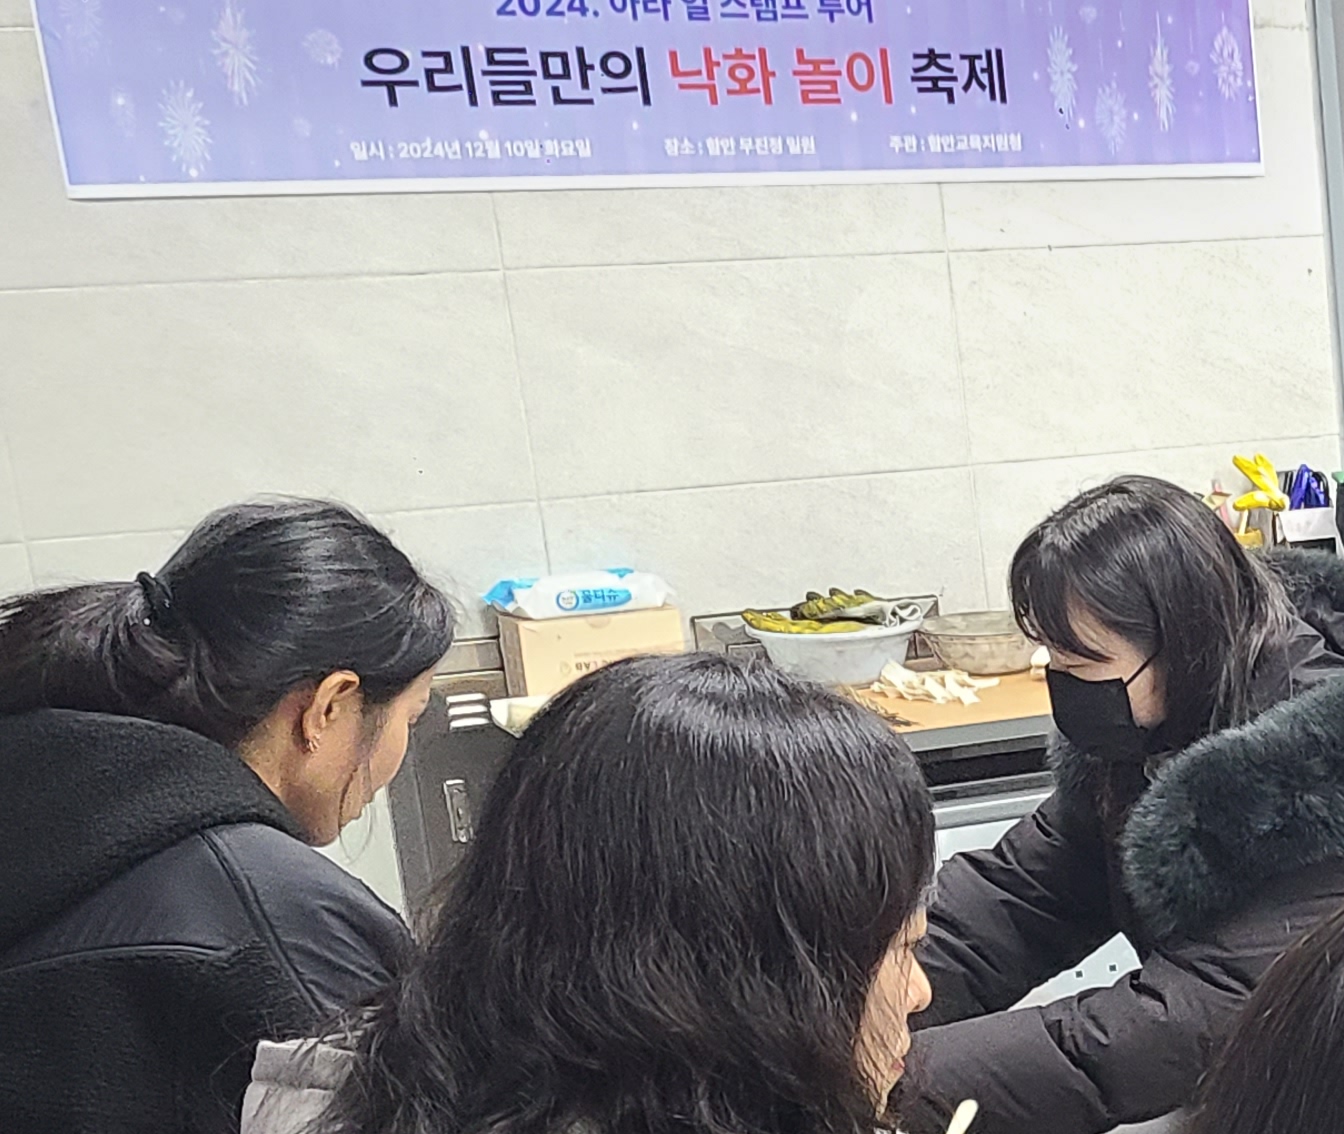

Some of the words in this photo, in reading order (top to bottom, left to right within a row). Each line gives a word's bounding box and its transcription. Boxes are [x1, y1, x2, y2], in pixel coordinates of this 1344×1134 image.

[817, 0, 874, 23] 투어
[360, 45, 652, 107] 우리들만의
[668, 46, 776, 106] 낙화
[792, 47, 893, 105] 놀이
[910, 47, 1007, 105] 축제
[350, 138, 385, 161] 일시
[399, 136, 462, 160] 2024년
[465, 139, 501, 159] 12월
[504, 139, 542, 158] 10일
[543, 137, 591, 158] 화요일
[581, 588, 619, 604] 물티슈
